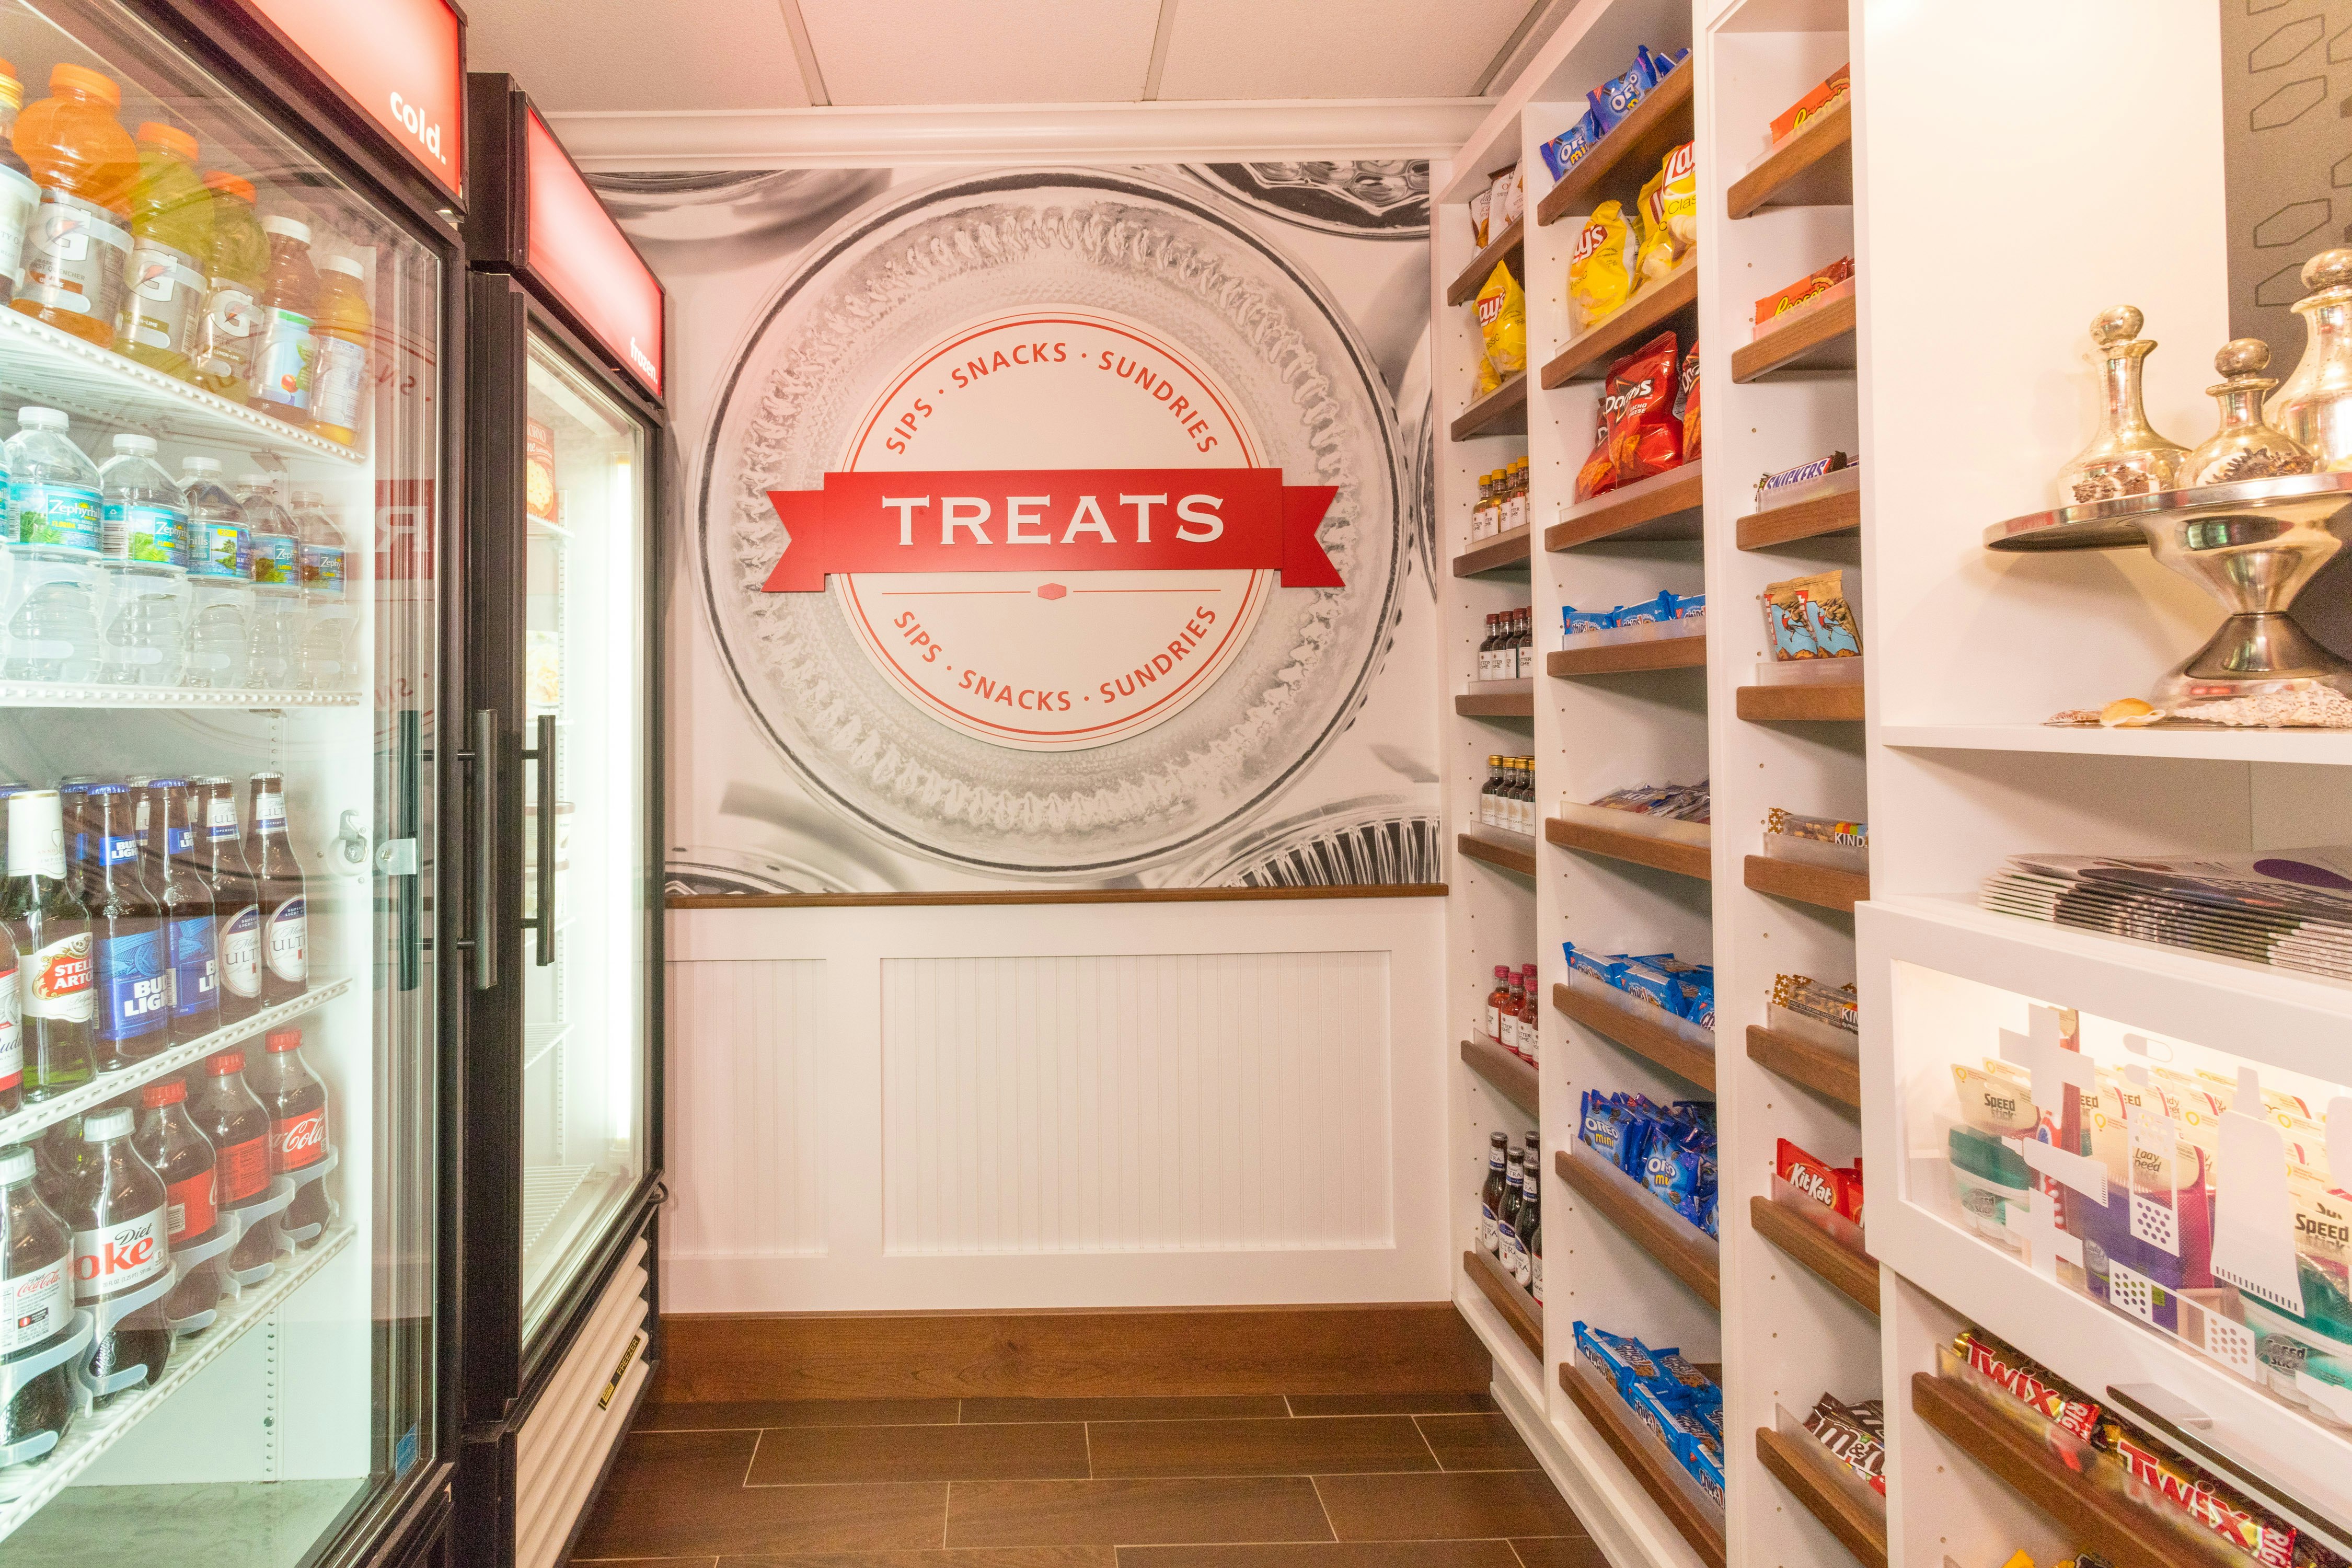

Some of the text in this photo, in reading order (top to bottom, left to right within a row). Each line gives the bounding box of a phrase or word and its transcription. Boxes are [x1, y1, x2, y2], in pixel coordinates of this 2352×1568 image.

[390, 91, 446, 165] cold.
[125, 315, 158, 328] LEN-LIME
[1480, 293, 1506, 328] ay's
[630, 336, 658, 385] frozen.
[886, 343, 1218, 454] SIPS SNACKS SUNDRIES
[1767, 459, 1828, 490] SNICKERS
[882, 492, 1225, 546] TREATS
[894, 606, 1216, 712] SIPS SNACKS SUNDRIES
[215, 814, 236, 824] ULT
[262, 806, 284, 817] ULT
[111, 847, 139, 859] LIGH
[54, 972, 93, 990] ARTO
[55, 960, 93, 977] STELL
[1585, 1117, 1619, 1139] OREO
[1595, 1133, 1615, 1148] mini
[115, 1223, 153, 1246] Diet
[74, 1237, 153, 1280] oke
[617, 1339, 638, 1376] FREEZER
